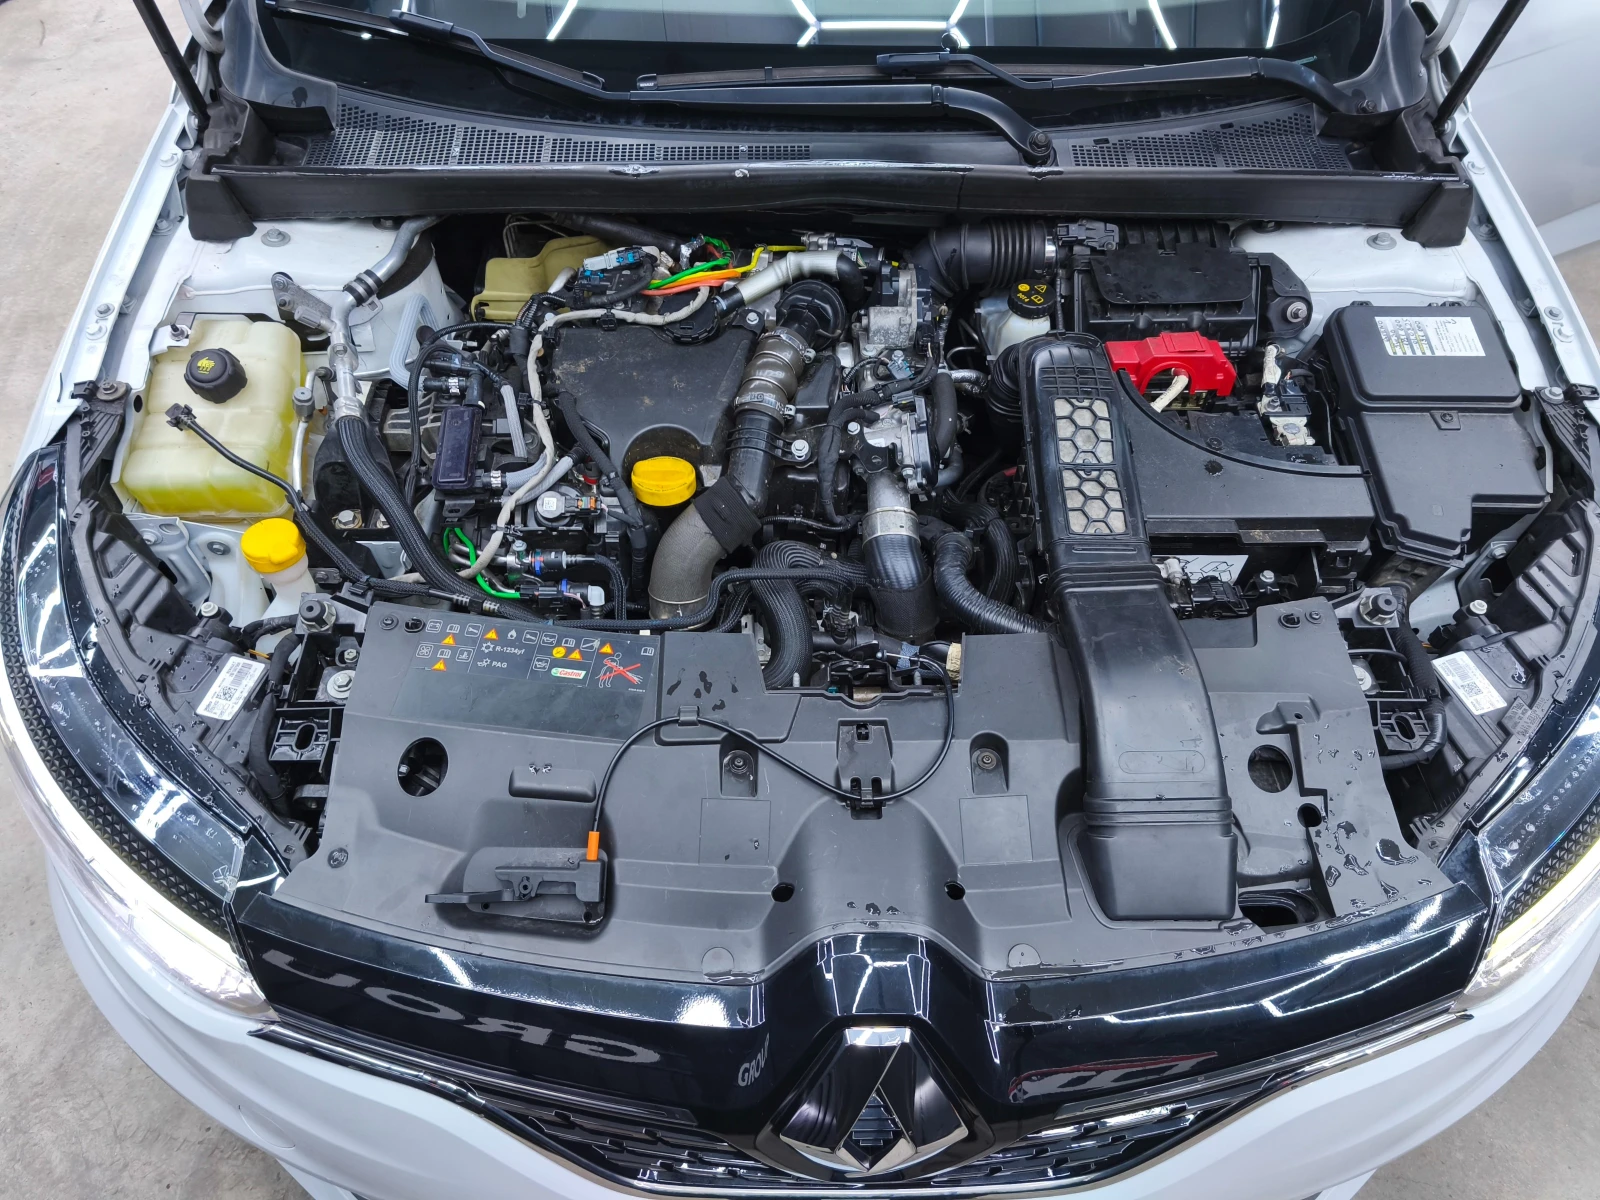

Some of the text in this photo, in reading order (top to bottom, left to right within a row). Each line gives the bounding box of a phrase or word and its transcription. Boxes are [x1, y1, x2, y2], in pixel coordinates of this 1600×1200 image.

[495, 645, 526, 656] R-1234yf
[491, 661, 508, 669] PAG
[559, 669, 583, 678] Castrol
